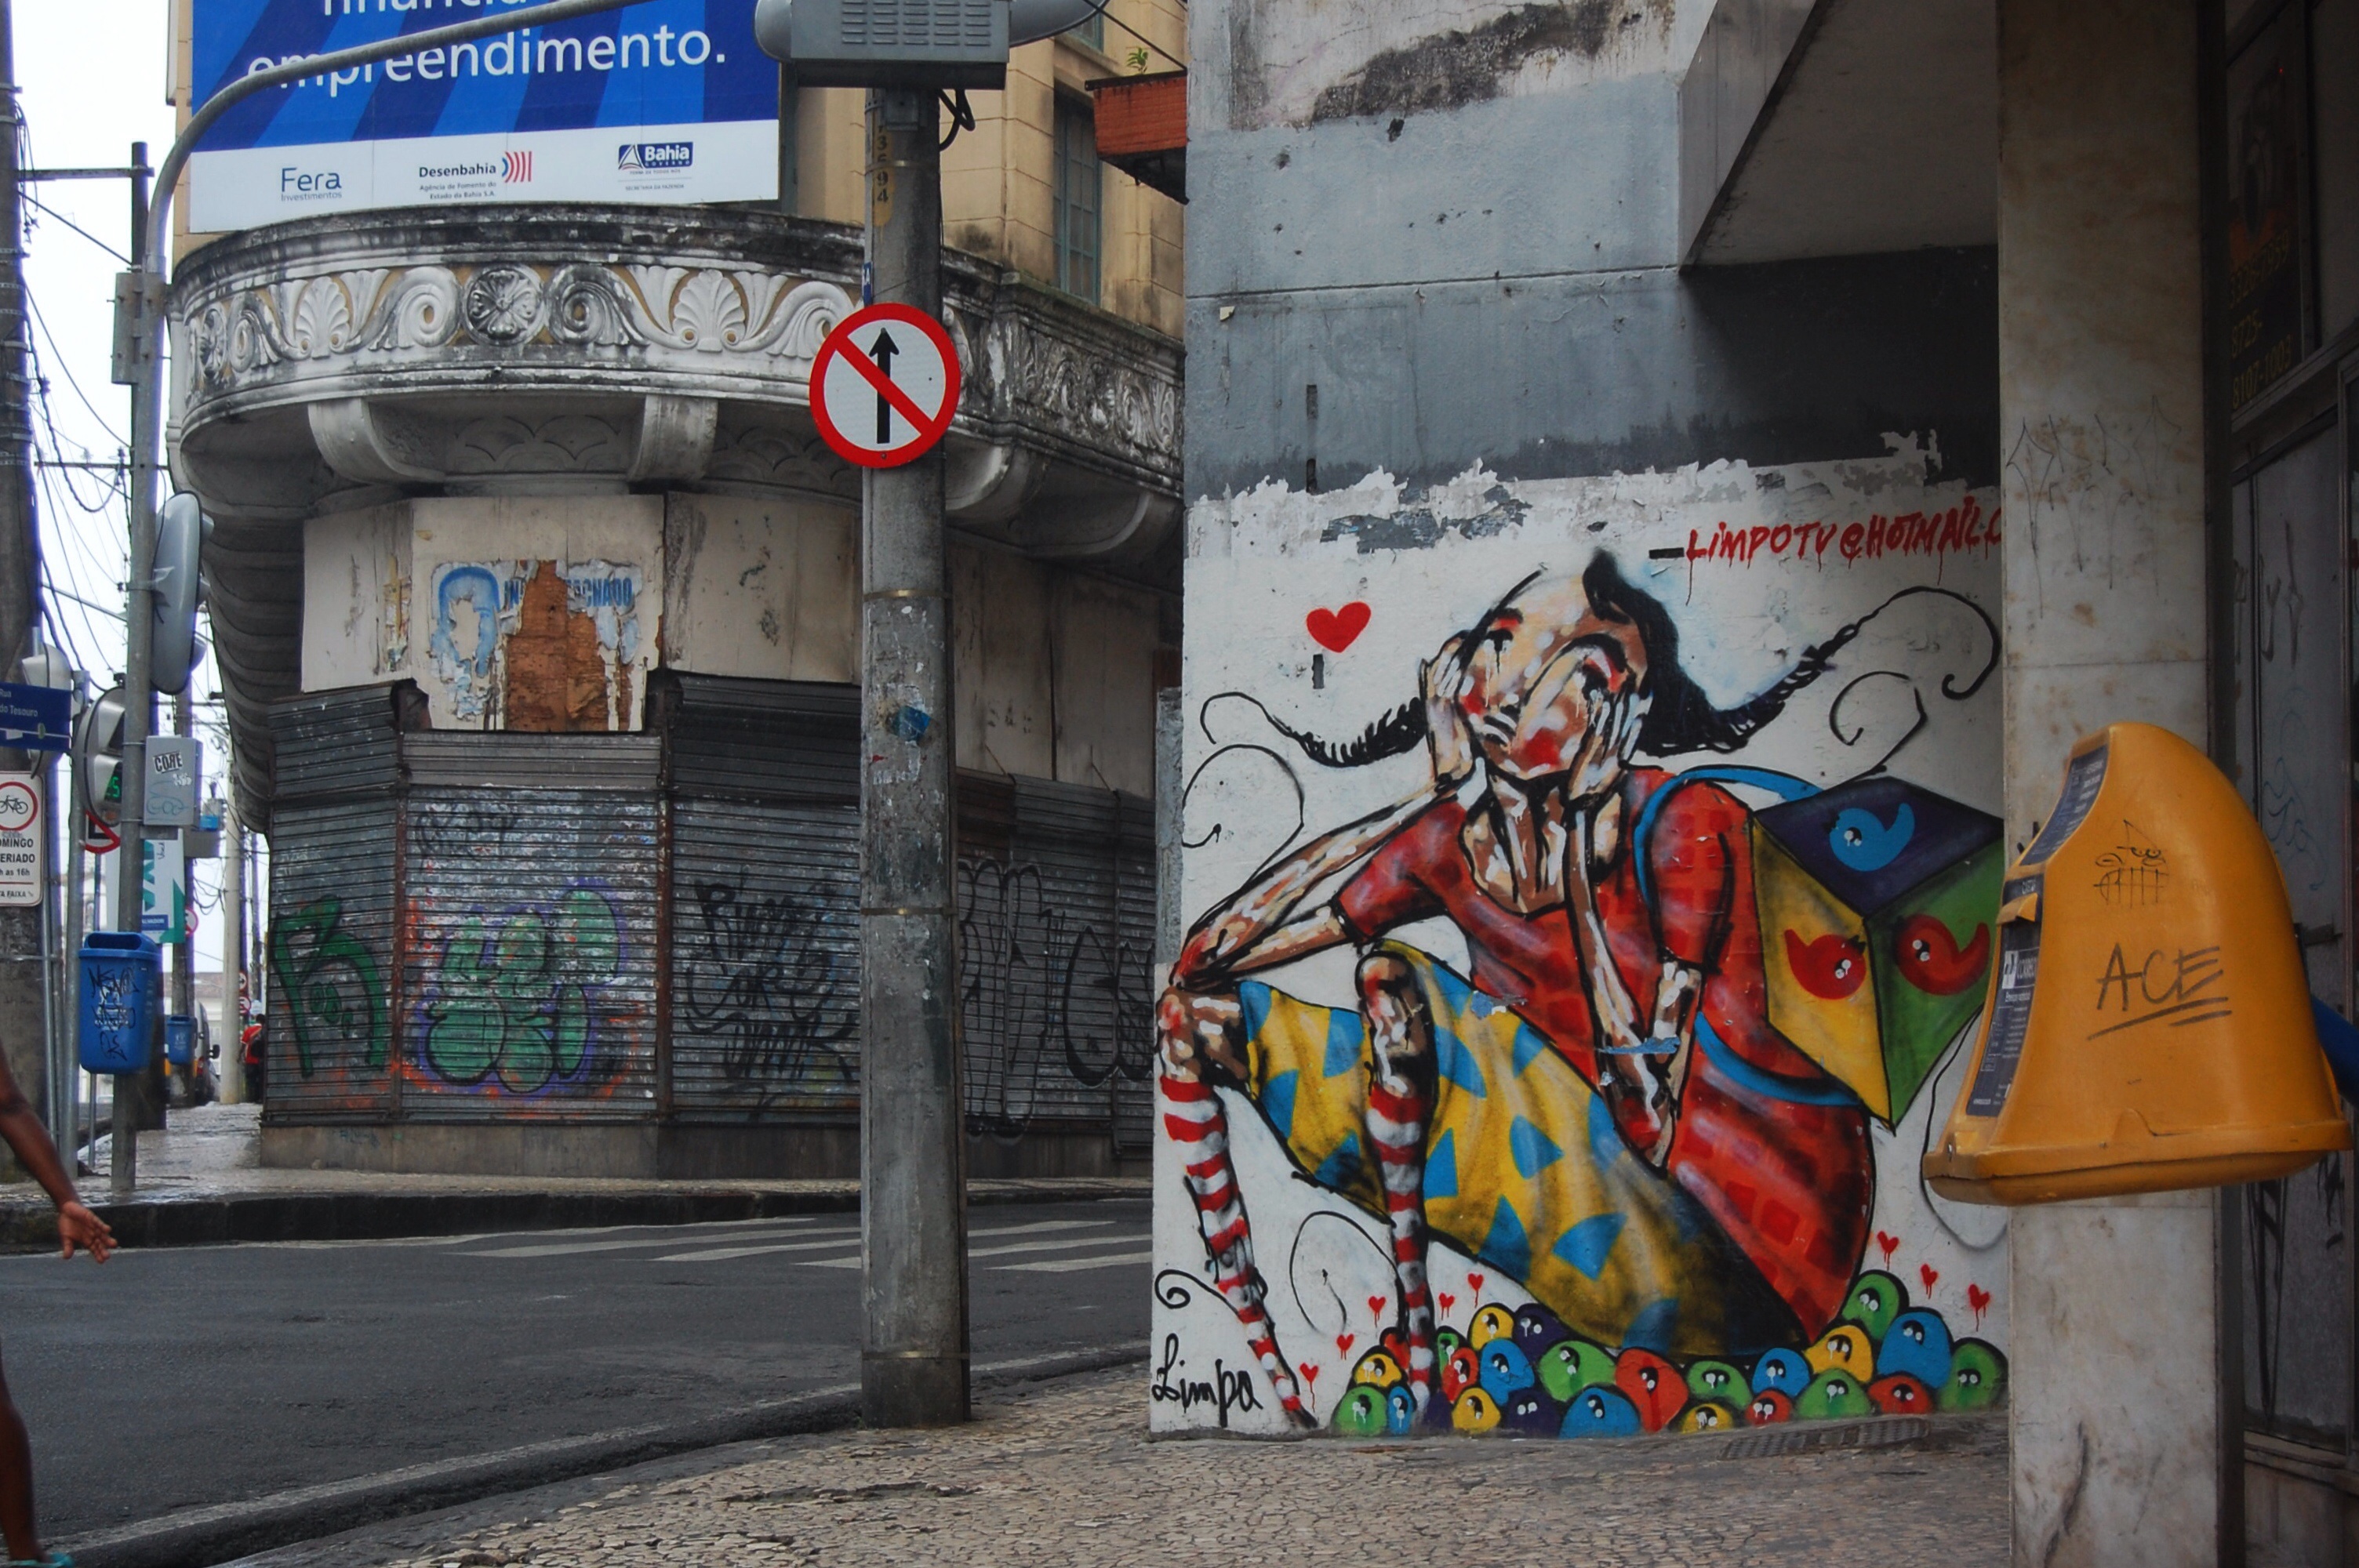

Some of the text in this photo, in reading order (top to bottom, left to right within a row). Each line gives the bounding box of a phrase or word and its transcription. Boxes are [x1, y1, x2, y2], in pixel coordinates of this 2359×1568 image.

[645, 144, 690, 162] Bahia
[419, 162, 496, 178] Desenbahia
[282, 167, 342, 192] Fera
[457, 181, 485, 190] Fomento
[281, 191, 342, 201] Investimentos
[10, 705, 38, 717] Tesouro
[0, 838, 34, 848] MINGO
[2096, 942, 2224, 1012] ACE
[1151, 1333, 1263, 1428] Limpa
